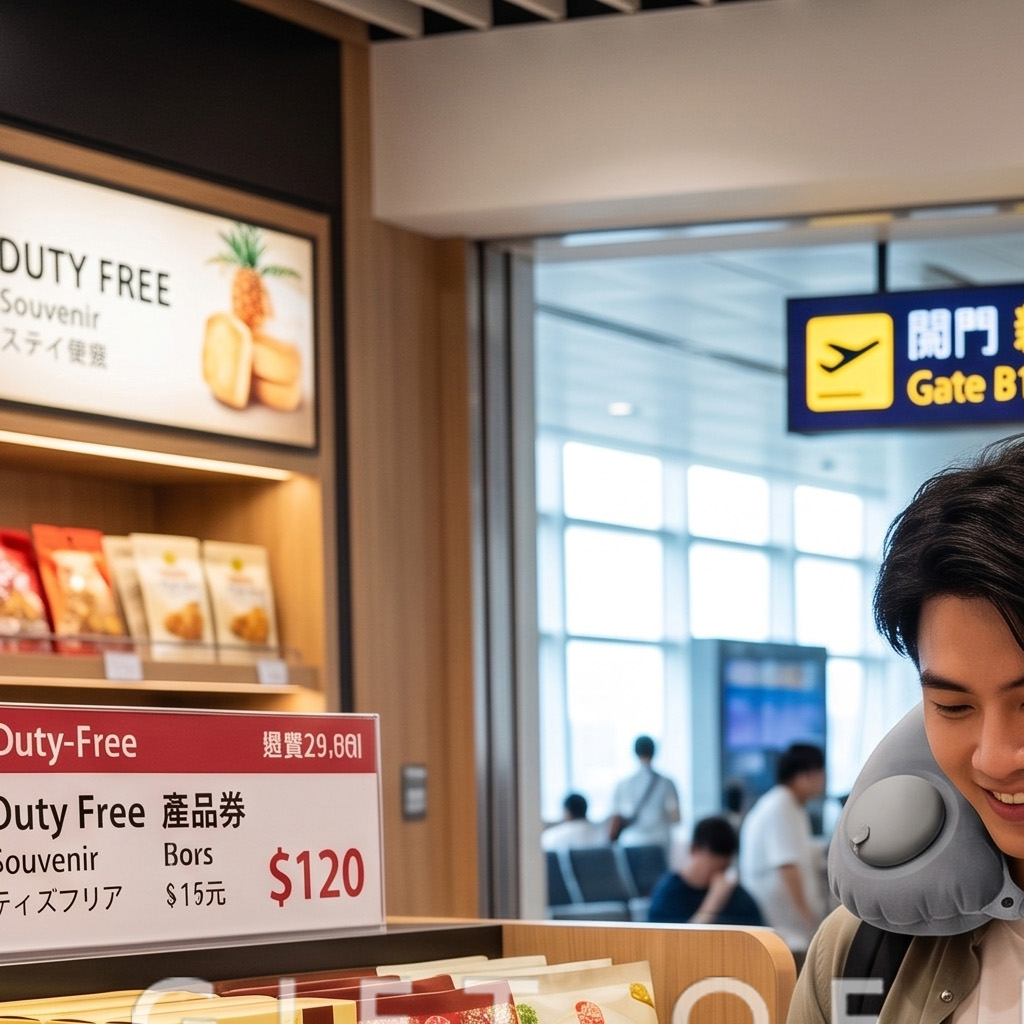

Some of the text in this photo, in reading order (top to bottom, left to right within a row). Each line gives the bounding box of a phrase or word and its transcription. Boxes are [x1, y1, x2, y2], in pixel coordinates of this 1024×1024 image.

[0, 237, 171, 307] DUTY FREE
[0, 288, 100, 330] Souvenir
[906, 369, 987, 406] Gate
[0, 722, 137, 766] Duty-Free
[78, 795, 146, 829] Free
[162, 791, 246, 829] 產品券
[164, 842, 213, 867] Bors
[269, 847, 366, 907] $120
